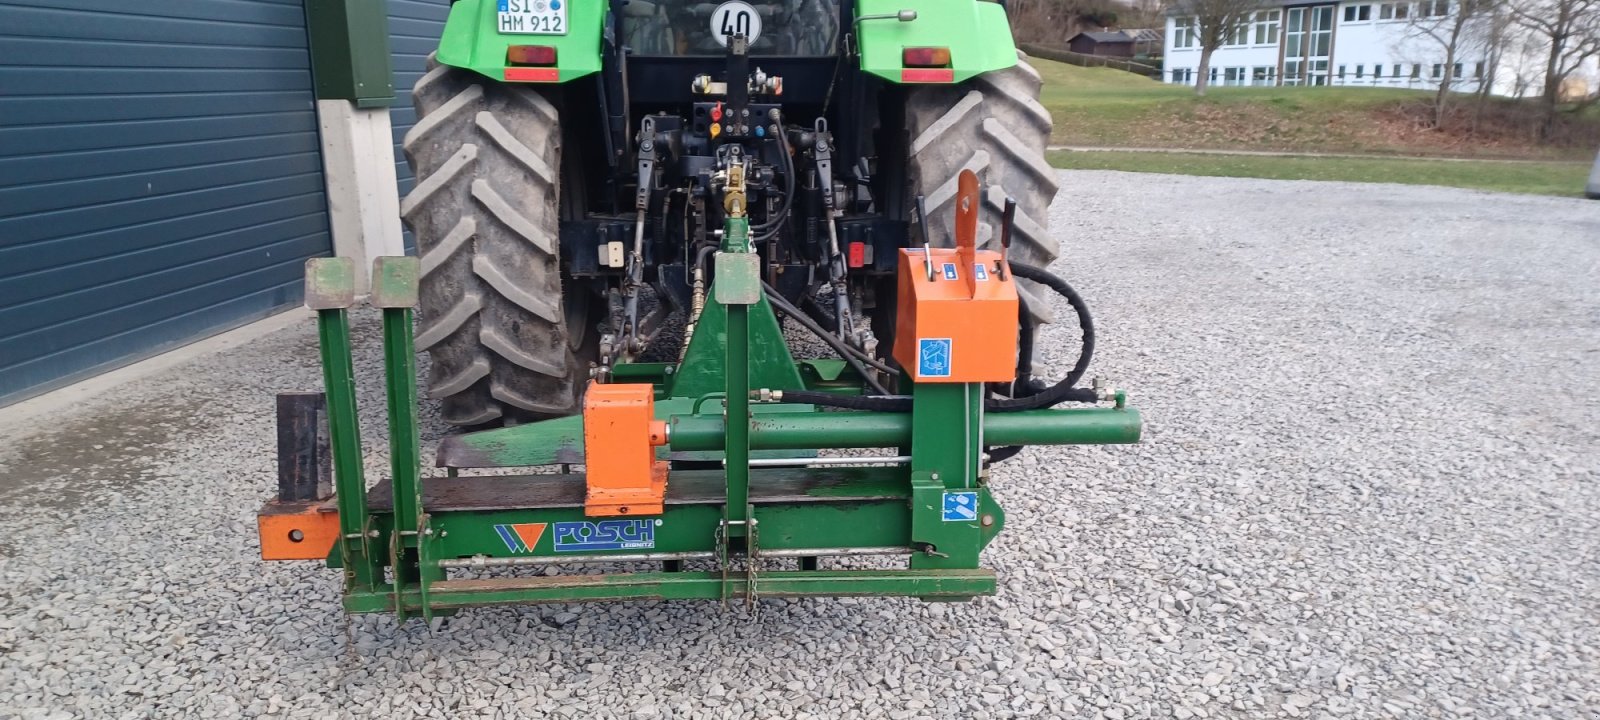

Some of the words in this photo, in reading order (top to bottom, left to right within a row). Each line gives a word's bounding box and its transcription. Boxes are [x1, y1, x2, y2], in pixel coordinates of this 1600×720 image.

[510, 0, 531, 13] SI
[502, 15, 523, 31] HM
[530, 15, 562, 32] 912
[721, 10, 750, 37] 40
[553, 519, 655, 544] POSCH
